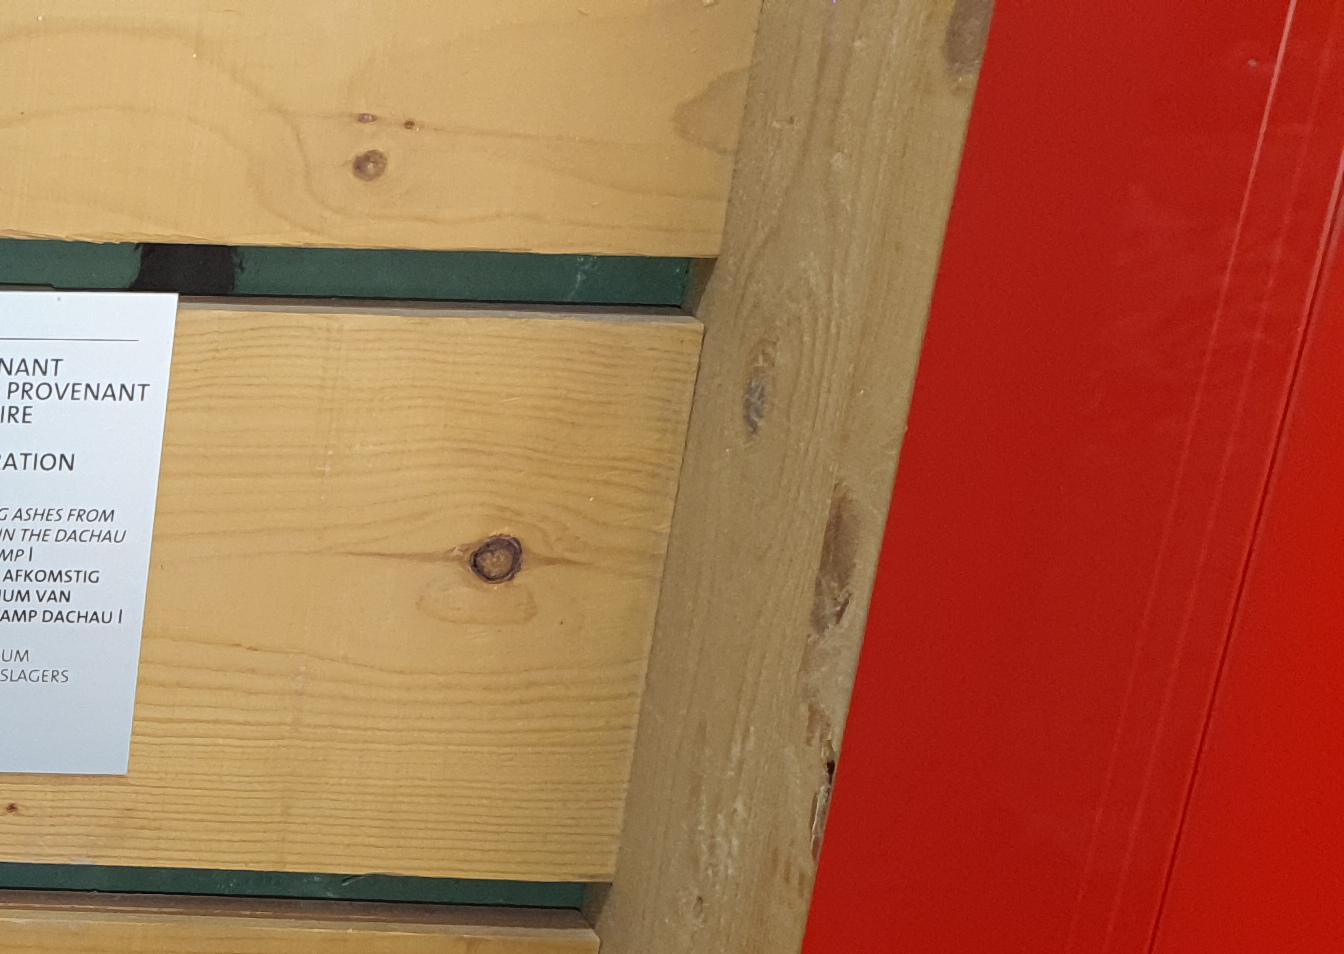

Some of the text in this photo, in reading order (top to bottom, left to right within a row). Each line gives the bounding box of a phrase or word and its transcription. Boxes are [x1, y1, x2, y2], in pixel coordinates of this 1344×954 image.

[7, 382, 150, 401] PROVENANT
[11, 508, 63, 522] ASHES
[67, 509, 115, 522] FROM
[21, 529, 52, 542] THE
[55, 529, 127, 543] DACHAU
[3, 570, 99, 583] AFKOMSTIG
[36, 590, 71, 603] VAN
[42, 610, 113, 624] DACHAU
